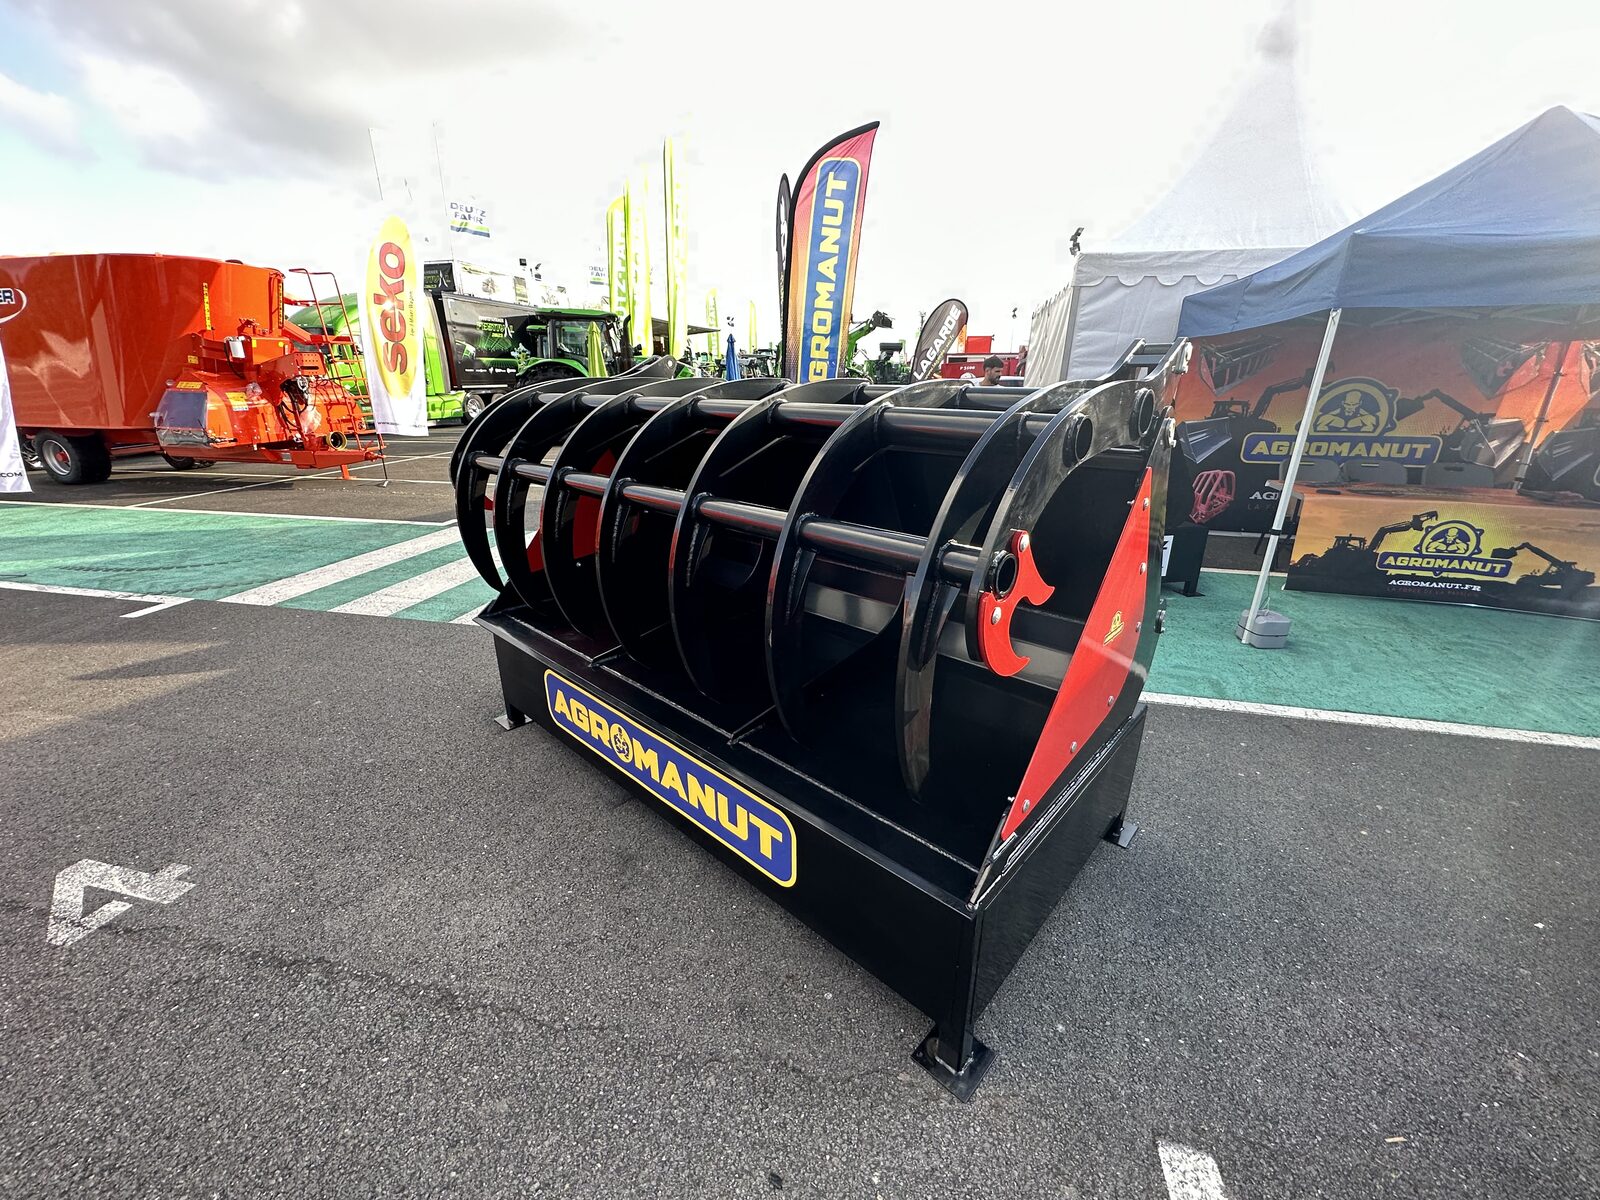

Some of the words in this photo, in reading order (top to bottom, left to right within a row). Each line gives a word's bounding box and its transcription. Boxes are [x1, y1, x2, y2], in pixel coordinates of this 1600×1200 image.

[450, 202, 487, 218] DEUTZ
[454, 211, 484, 225] FAHR
[808, 171, 849, 383] GROMANUT
[0, 289, 13, 303] R
[373, 241, 408, 375] seko
[912, 304, 962, 380] LAGARDE
[1384, 555, 1507, 574] AGROMANUT
[1388, 579, 1482, 592] AGROMANUT.FR
[554, 689, 783, 860] AGROMANUT
